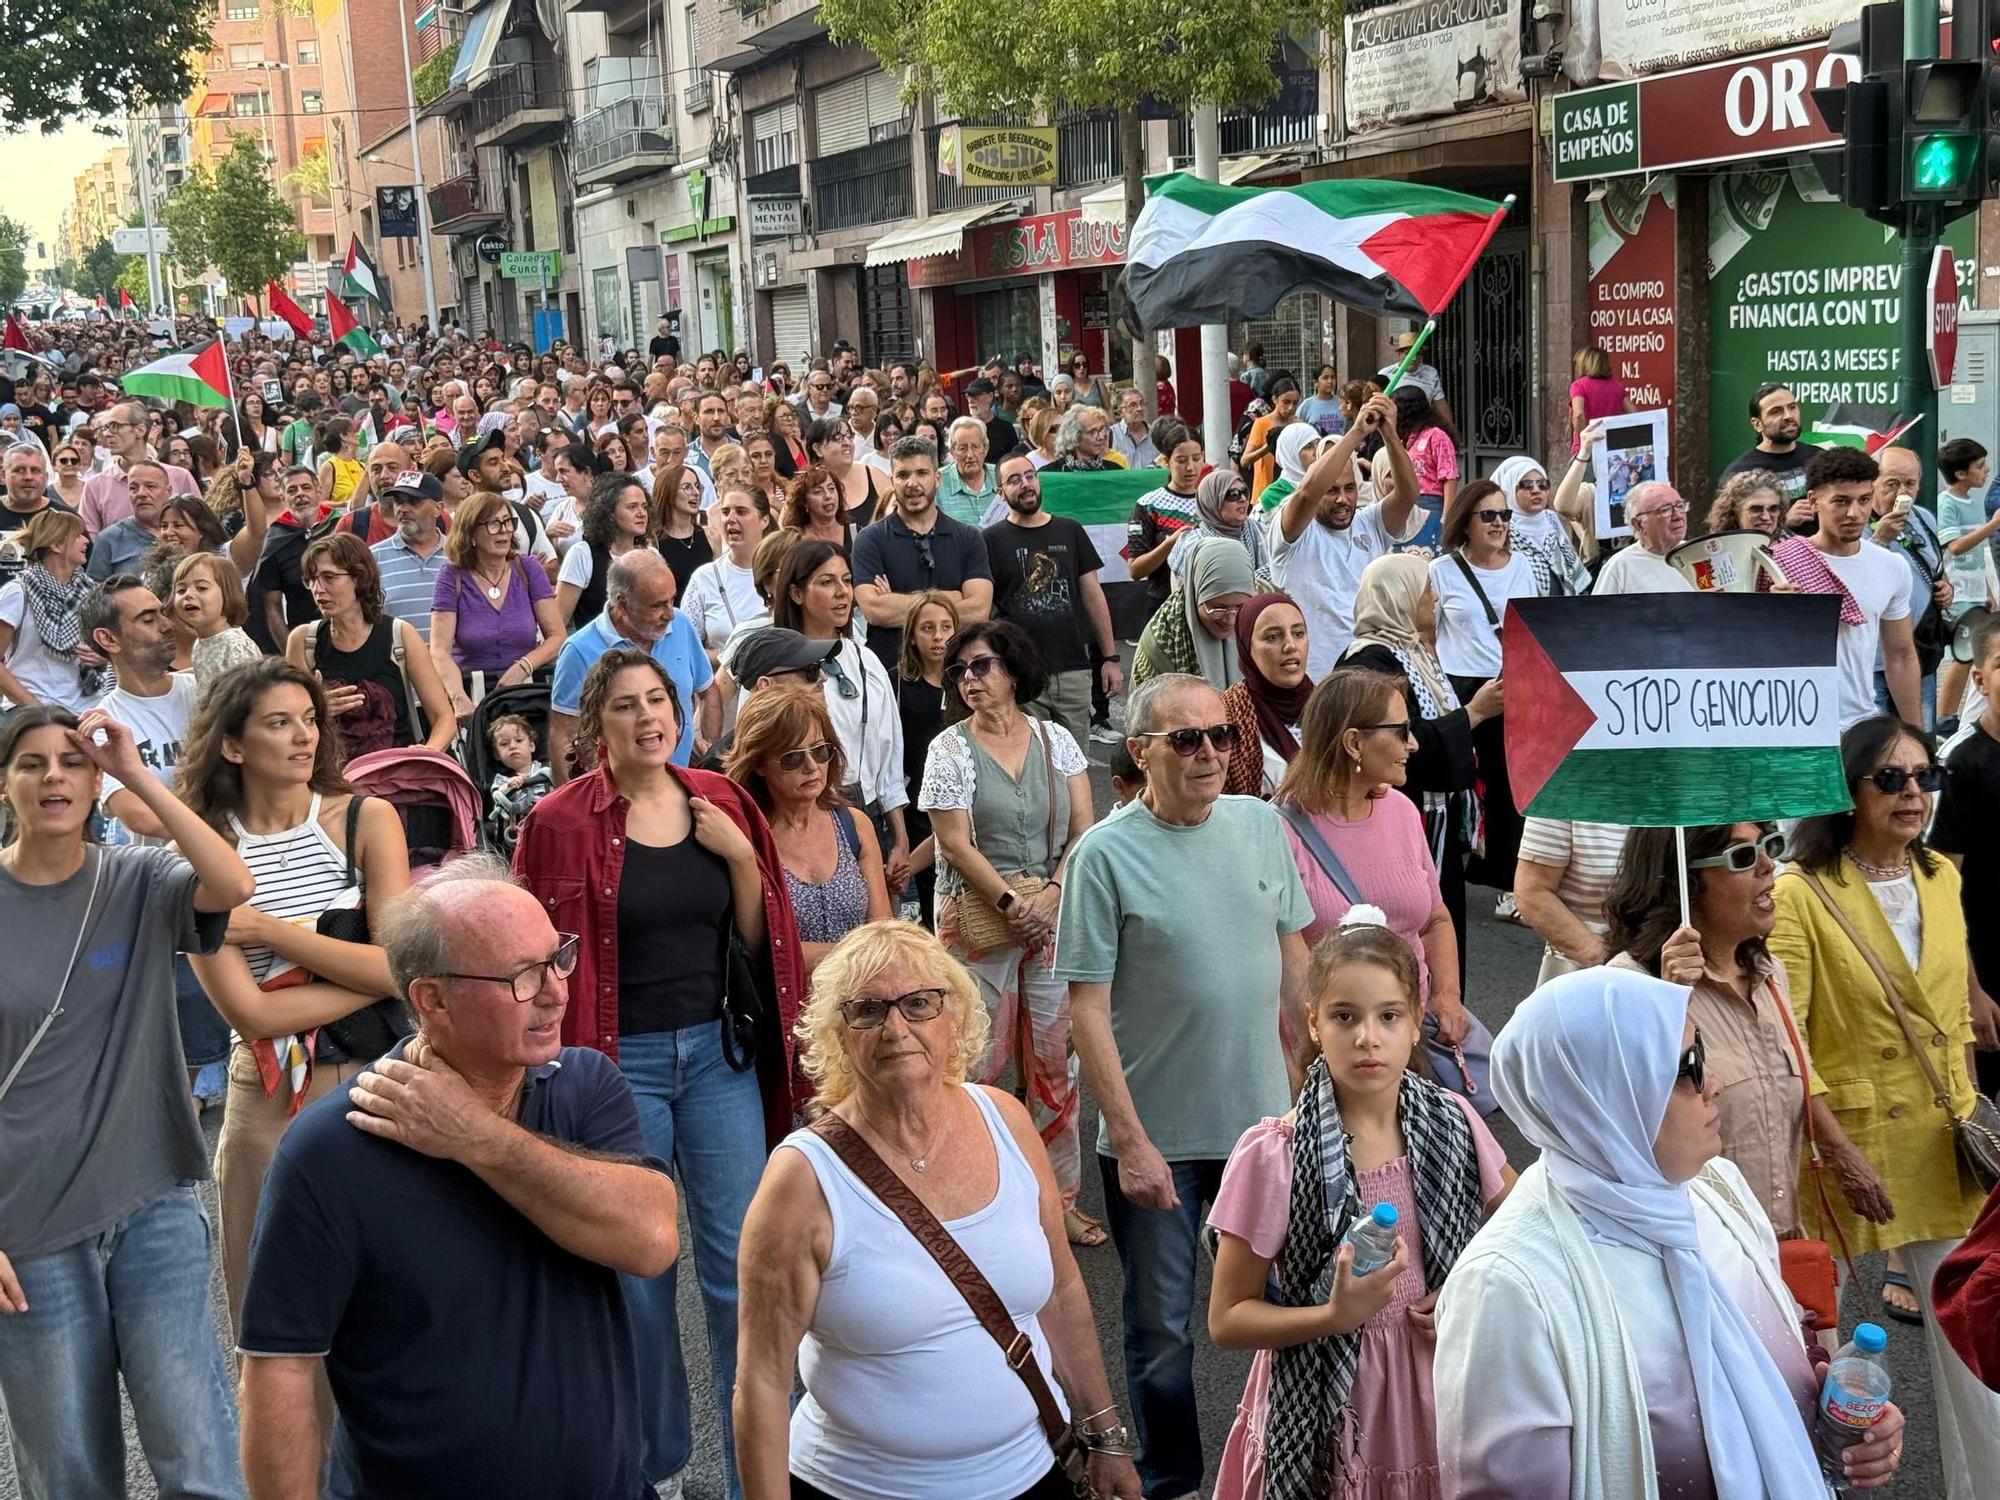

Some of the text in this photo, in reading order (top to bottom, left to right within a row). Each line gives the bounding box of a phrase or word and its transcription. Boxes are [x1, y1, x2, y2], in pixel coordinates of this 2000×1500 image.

[1355, 6, 1427, 50] ACADEMIA
[1562, 100, 1629, 134] CASA DE
[998, 133, 1008, 143] DE
[1558, 129, 1635, 164] EMPEÑOS
[974, 144, 1045, 169] DISLEXIA
[1017, 169, 1031, 181] DEL
[1032, 160, 1054, 177] HABLA
[755, 213, 797, 223] MENTAL
[757, 202, 793, 212] SALUD
[481, 242, 505, 250] takto
[988, 221, 1062, 272] ASIA
[506, 253, 552, 263] Calzados
[1598, 280, 1665, 301] EL COMPRO
[1737, 269, 1820, 302] ¿GASTOS
[1590, 307, 1674, 328] ORO Y LA CASA
[1729, 300, 1819, 330] FINANCIA
[1822, 299, 1867, 327] CON
[1935, 302, 1957, 334] STOP
[1598, 331, 1666, 353] DE EMPEÑO
[1621, 361, 1641, 379] N.1
[1767, 350, 1818, 372] HASTA
[1820, 349, 1830, 371] 3
[1836, 348, 1886, 371] MESES
[1855, 381, 1888, 404] TUS
[1605, 675, 1819, 736] STOP GENOCIDIO
